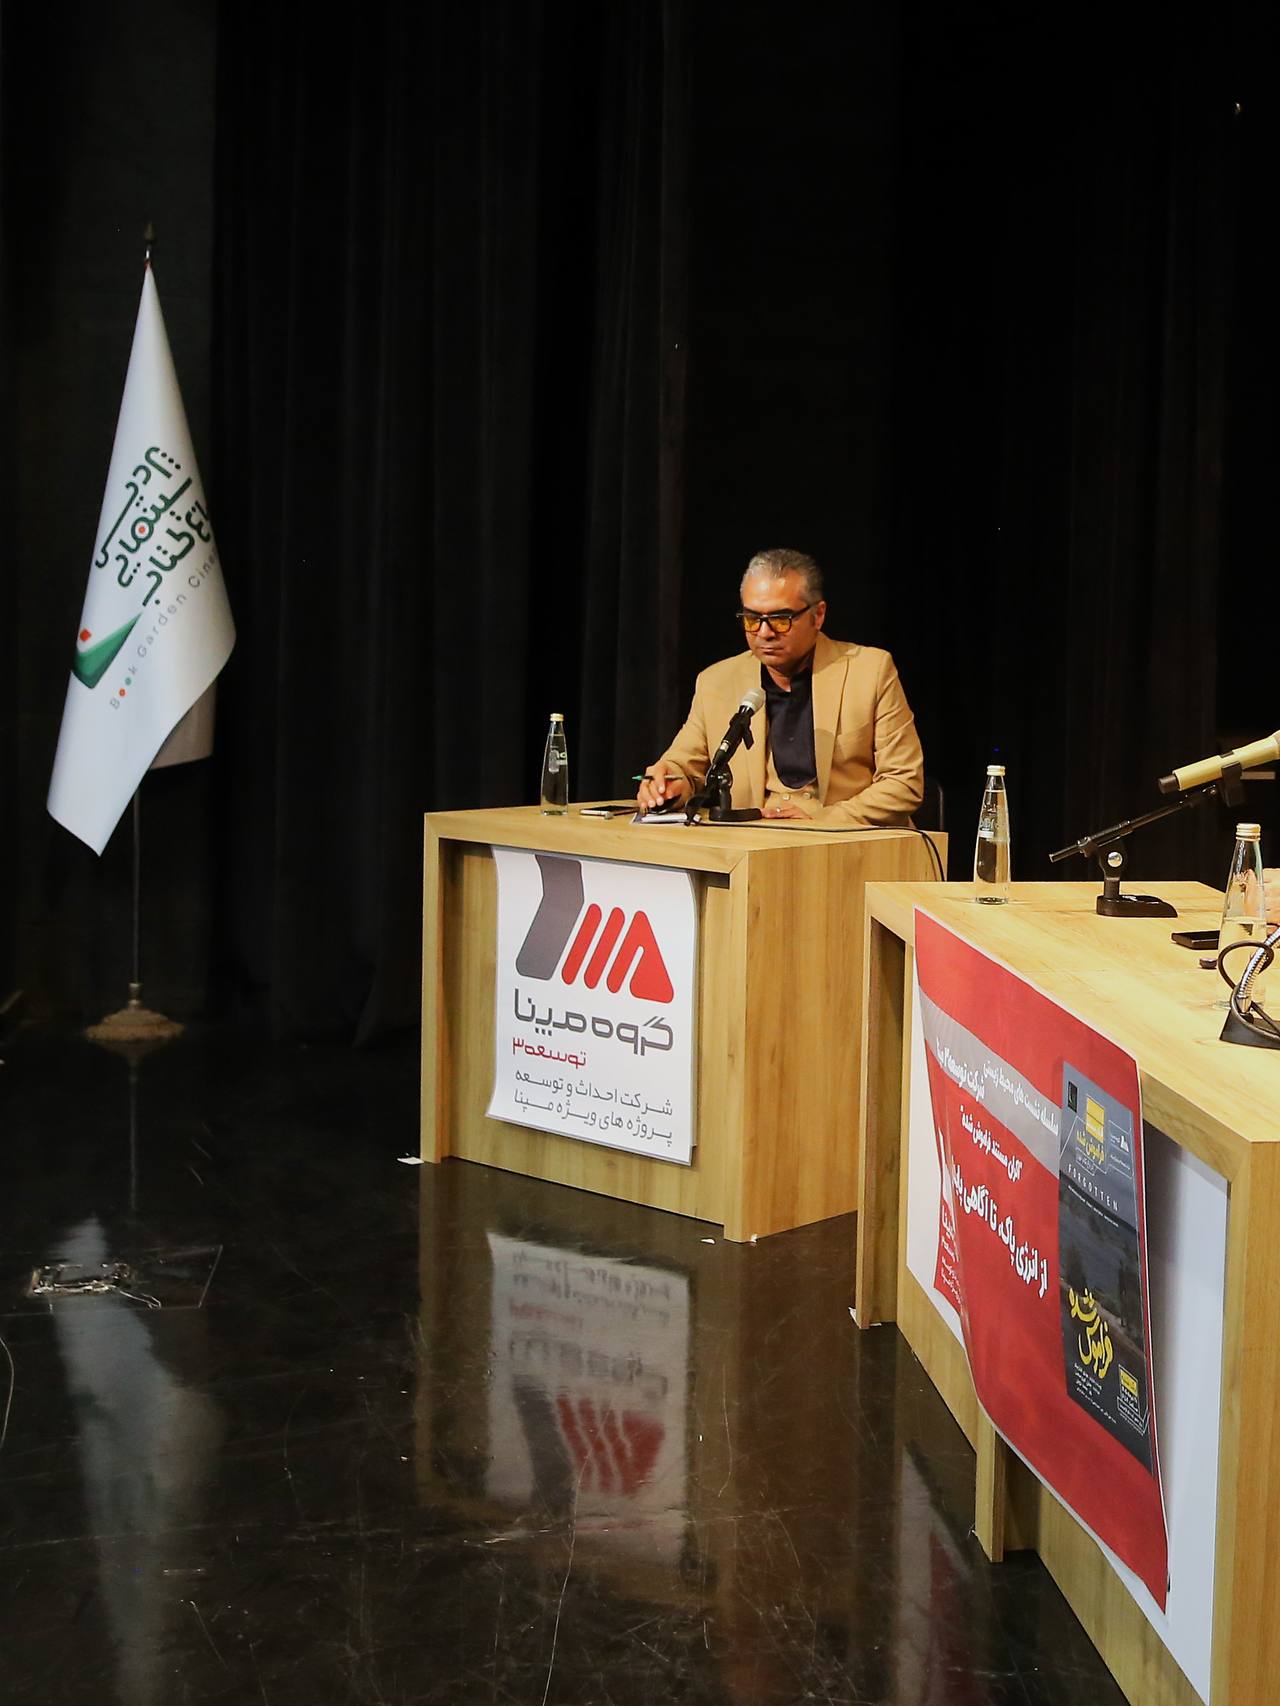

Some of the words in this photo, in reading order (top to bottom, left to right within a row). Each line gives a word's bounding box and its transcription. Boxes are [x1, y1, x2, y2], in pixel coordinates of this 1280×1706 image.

[137, 593, 187, 658] Garden
[188, 552, 219, 589] Cine
[514, 988, 587, 1036] مپنا
[515, 1069, 564, 1094] توسعه
[566, 1083, 573, 1097] و
[575, 1079, 618, 1102] احداث
[514, 1089, 554, 1113] مپنا
[556, 1099, 597, 1126] ویژه
[620, 1093, 674, 1116] شرکت
[599, 1111, 624, 1130] های
[627, 1115, 673, 1147] پروژه
[963, 1184, 989, 1222] آگاهی
[1068, 1163, 1119, 1212] FORGOTTEN
[989, 1199, 998, 1231] تا
[1016, 1241, 1038, 1285] انرژی
[1038, 1258, 1048, 1299] از
